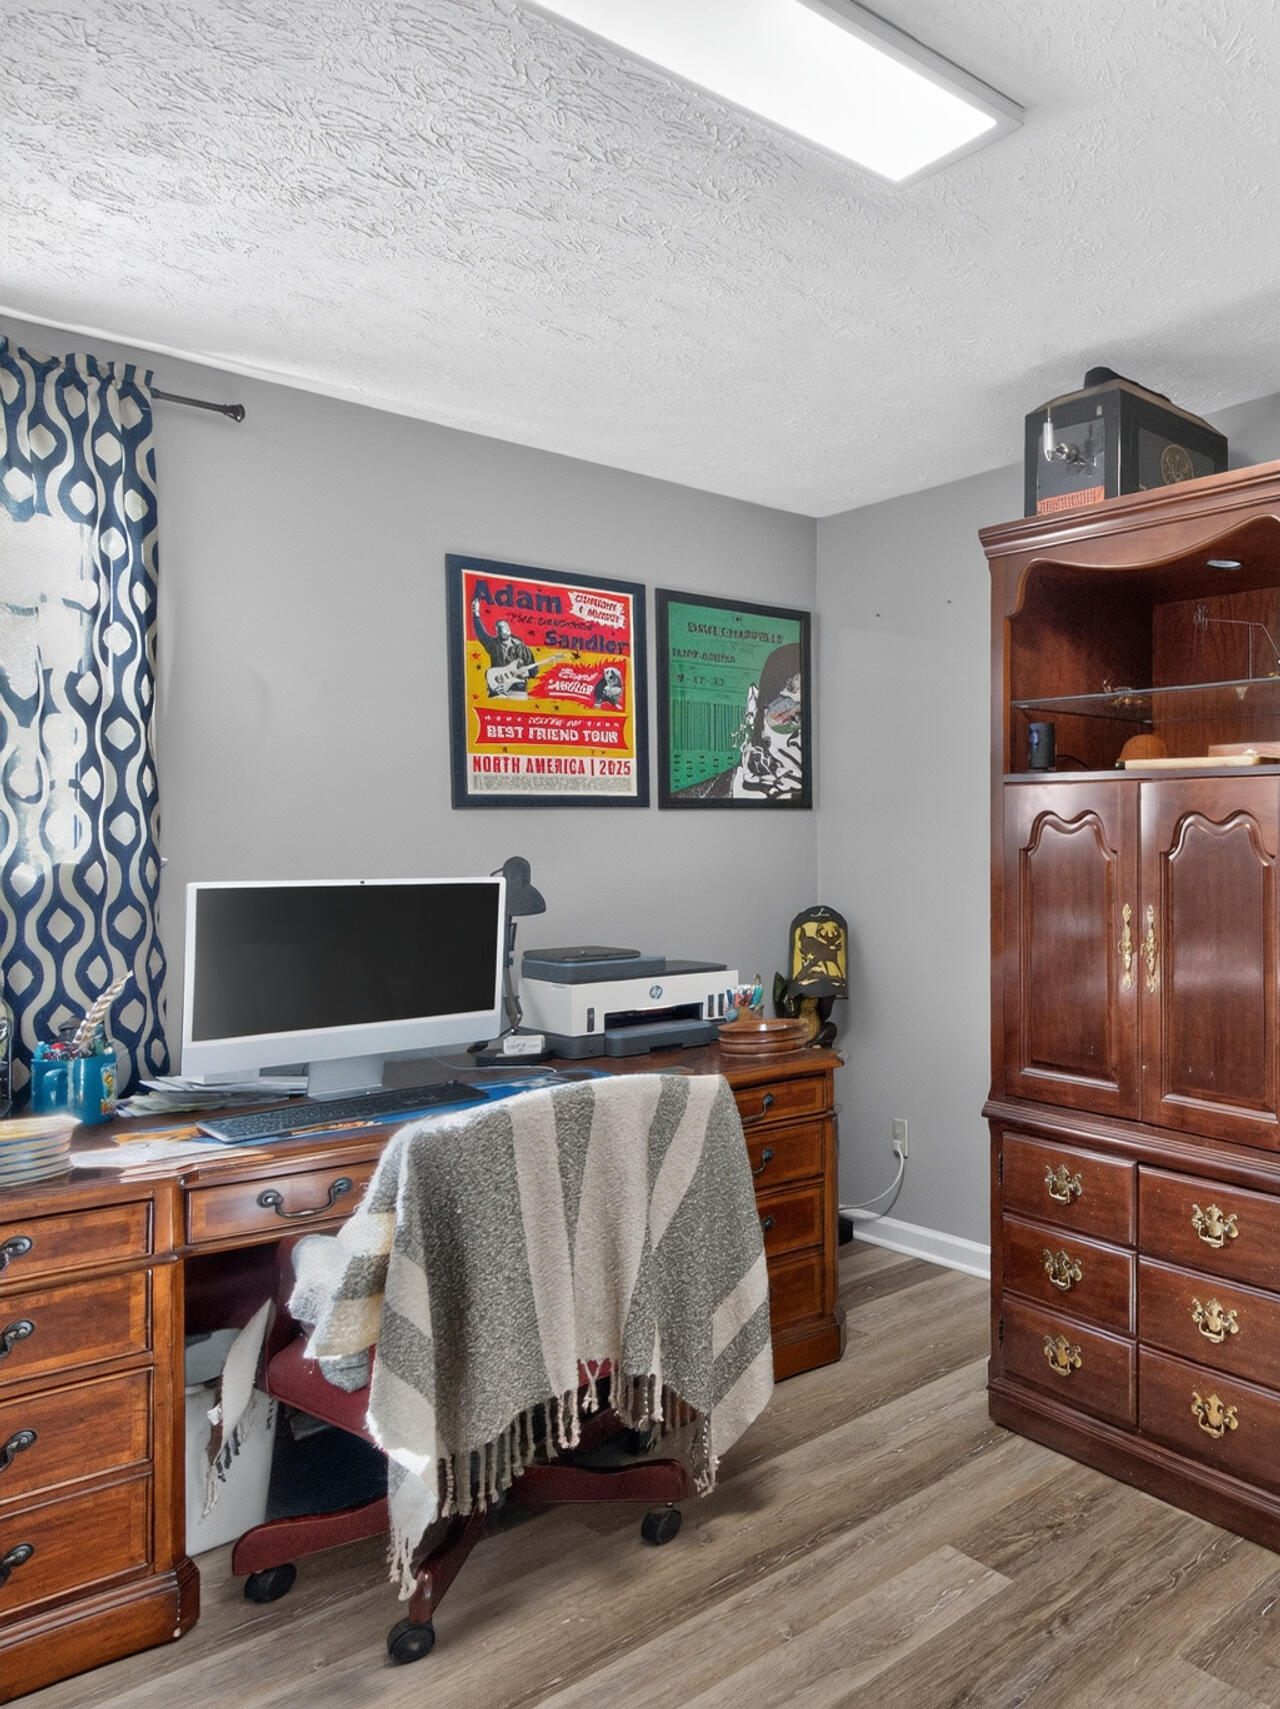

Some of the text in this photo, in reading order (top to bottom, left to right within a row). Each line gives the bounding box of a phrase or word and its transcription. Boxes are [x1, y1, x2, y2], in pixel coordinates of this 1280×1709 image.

[474, 579, 562, 614] Adam
[545, 629, 630, 655] Sandler
[486, 724, 618, 744] BEST FRIEND TOUR
[472, 755, 520, 774] NORTH
[525, 757, 586, 775] AMERICA
[599, 760, 631, 776] 2025
